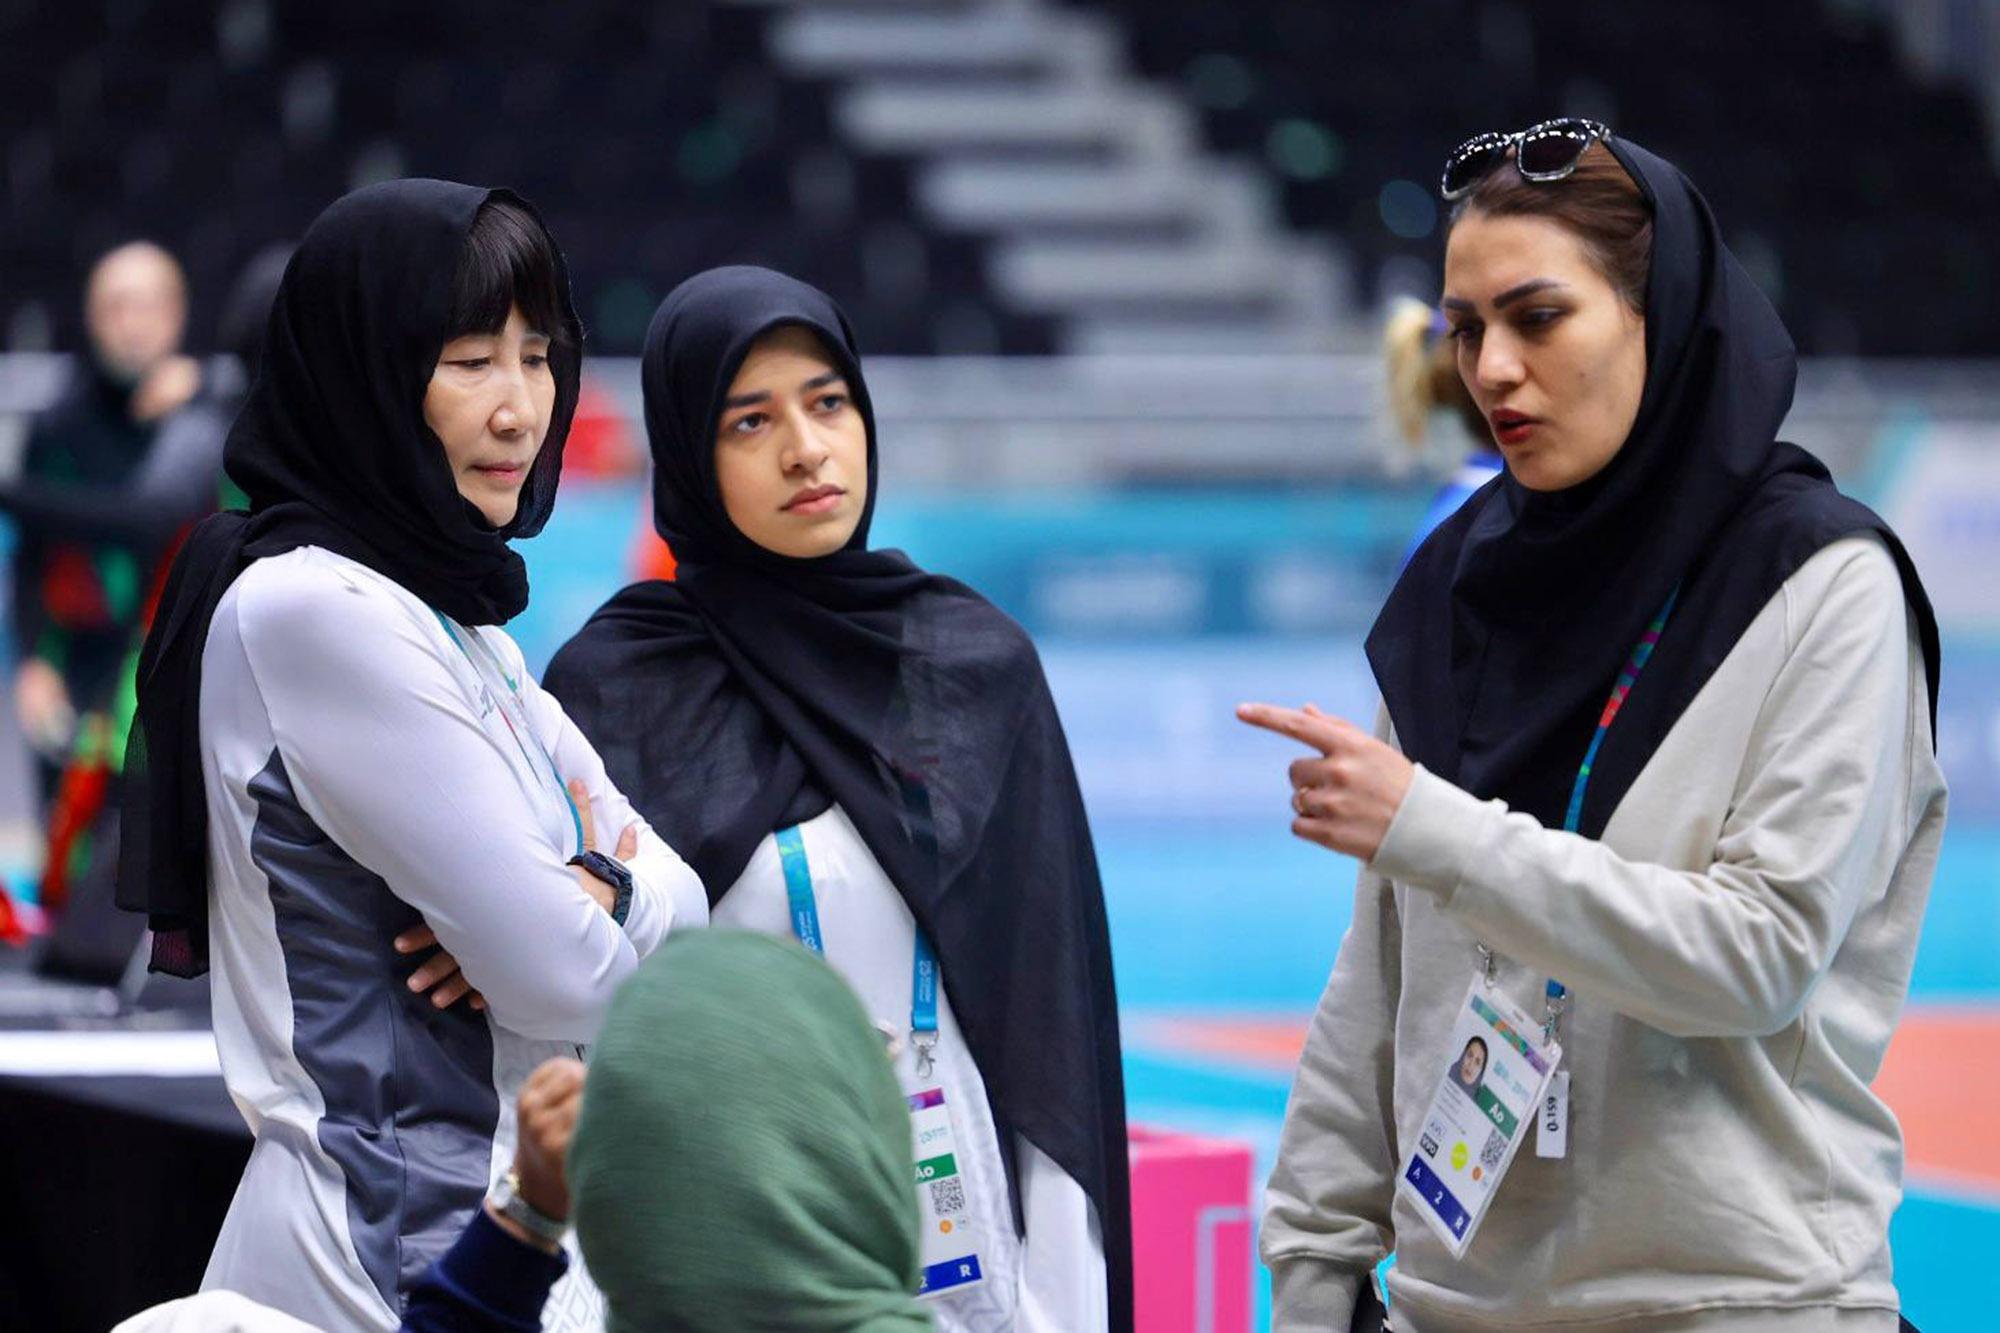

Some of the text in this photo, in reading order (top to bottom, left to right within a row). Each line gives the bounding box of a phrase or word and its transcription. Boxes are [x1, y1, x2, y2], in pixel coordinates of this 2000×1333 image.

[1413, 1167, 1421, 1180] A
[1434, 1191, 1443, 1205] 2
[959, 1264, 972, 1278] R
